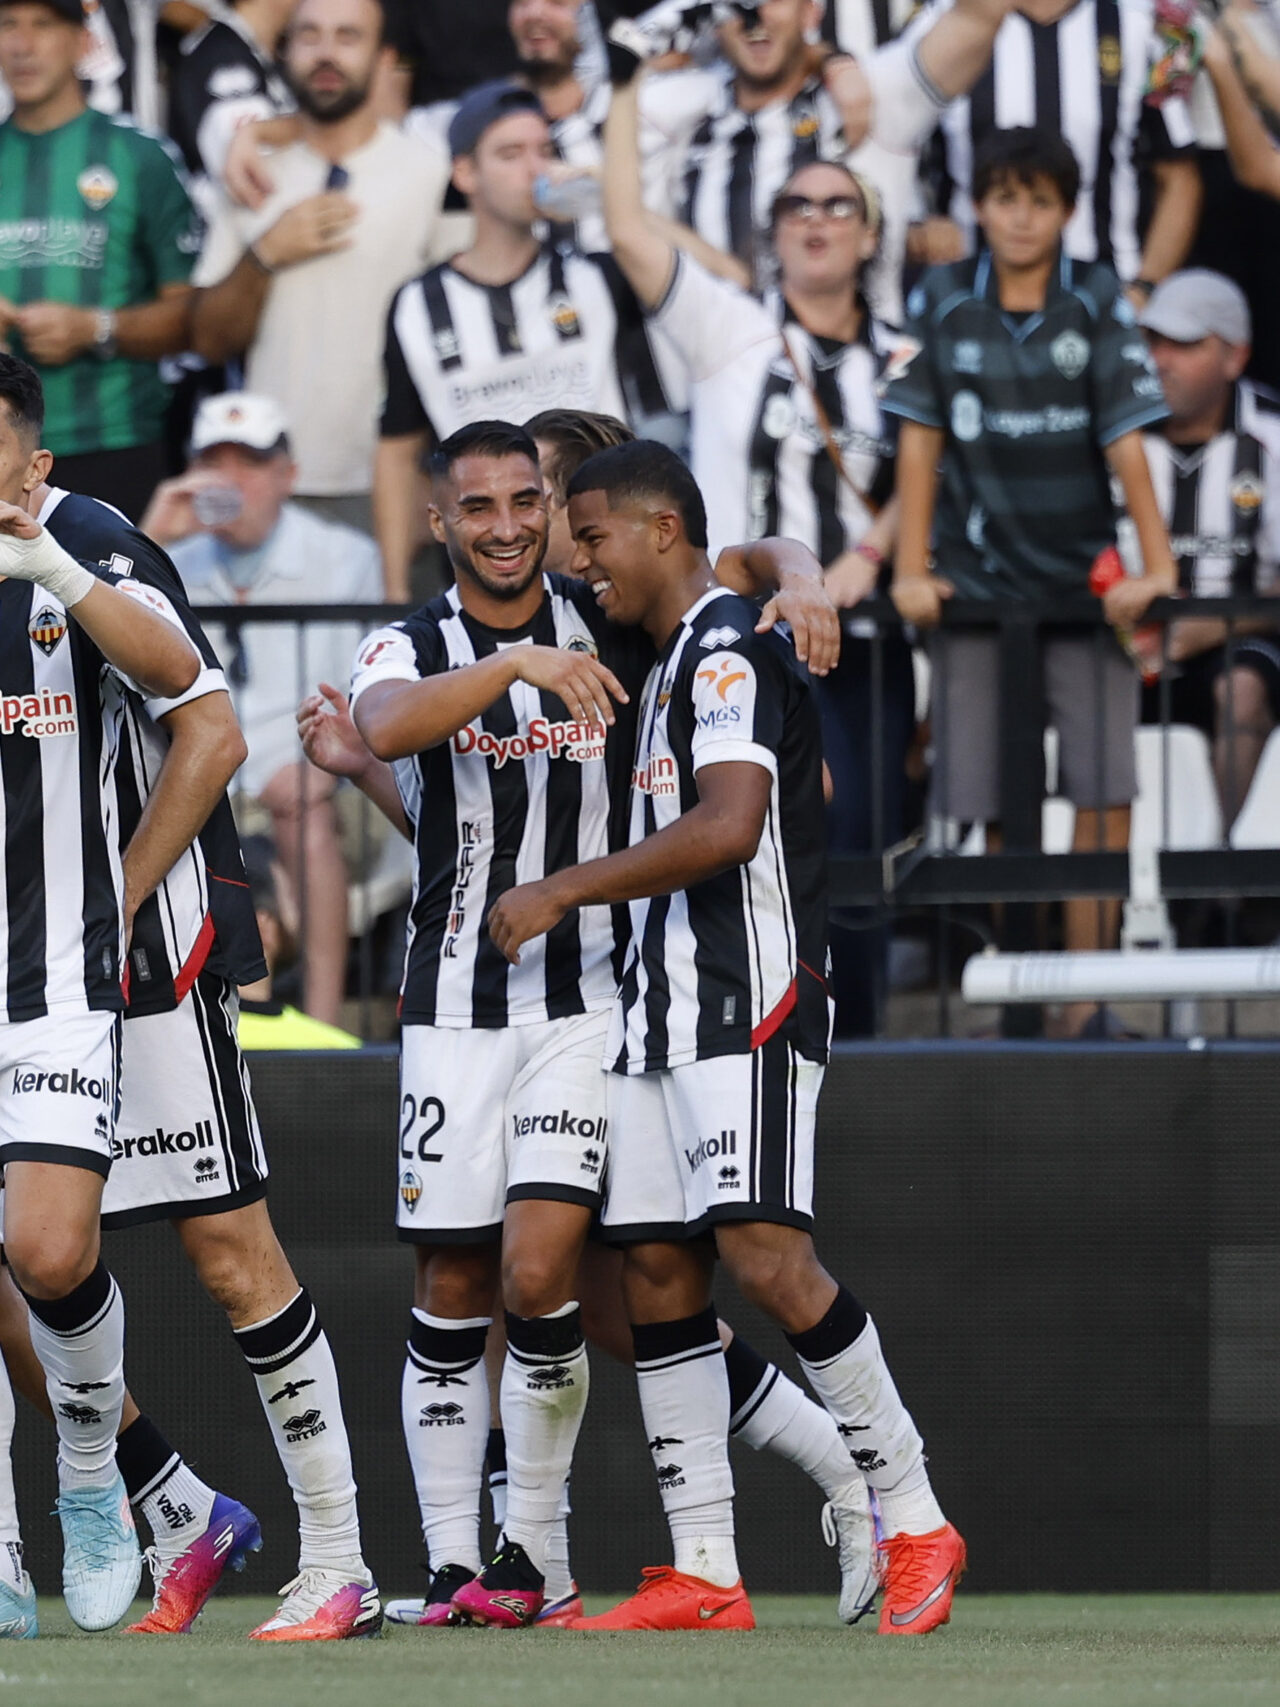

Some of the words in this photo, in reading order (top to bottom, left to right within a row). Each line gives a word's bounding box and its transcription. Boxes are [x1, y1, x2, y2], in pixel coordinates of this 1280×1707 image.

[24, 719, 76, 736] .com
[697, 705, 741, 730] MGS
[12, 1068, 110, 1107] kerakoll
[401, 1093, 446, 1163] 22
[513, 1109, 608, 1144] kerakoll
[112, 1119, 215, 1161] erakoll
[195, 1170, 221, 1184] errea
[717, 1180, 741, 1190] errea
[526, 1377, 575, 1391] errea
[286, 1420, 328, 1443] errea
[418, 1416, 468, 1428] errea
[156, 1494, 186, 1530] AURA
[177, 1502, 197, 1523] PRO
